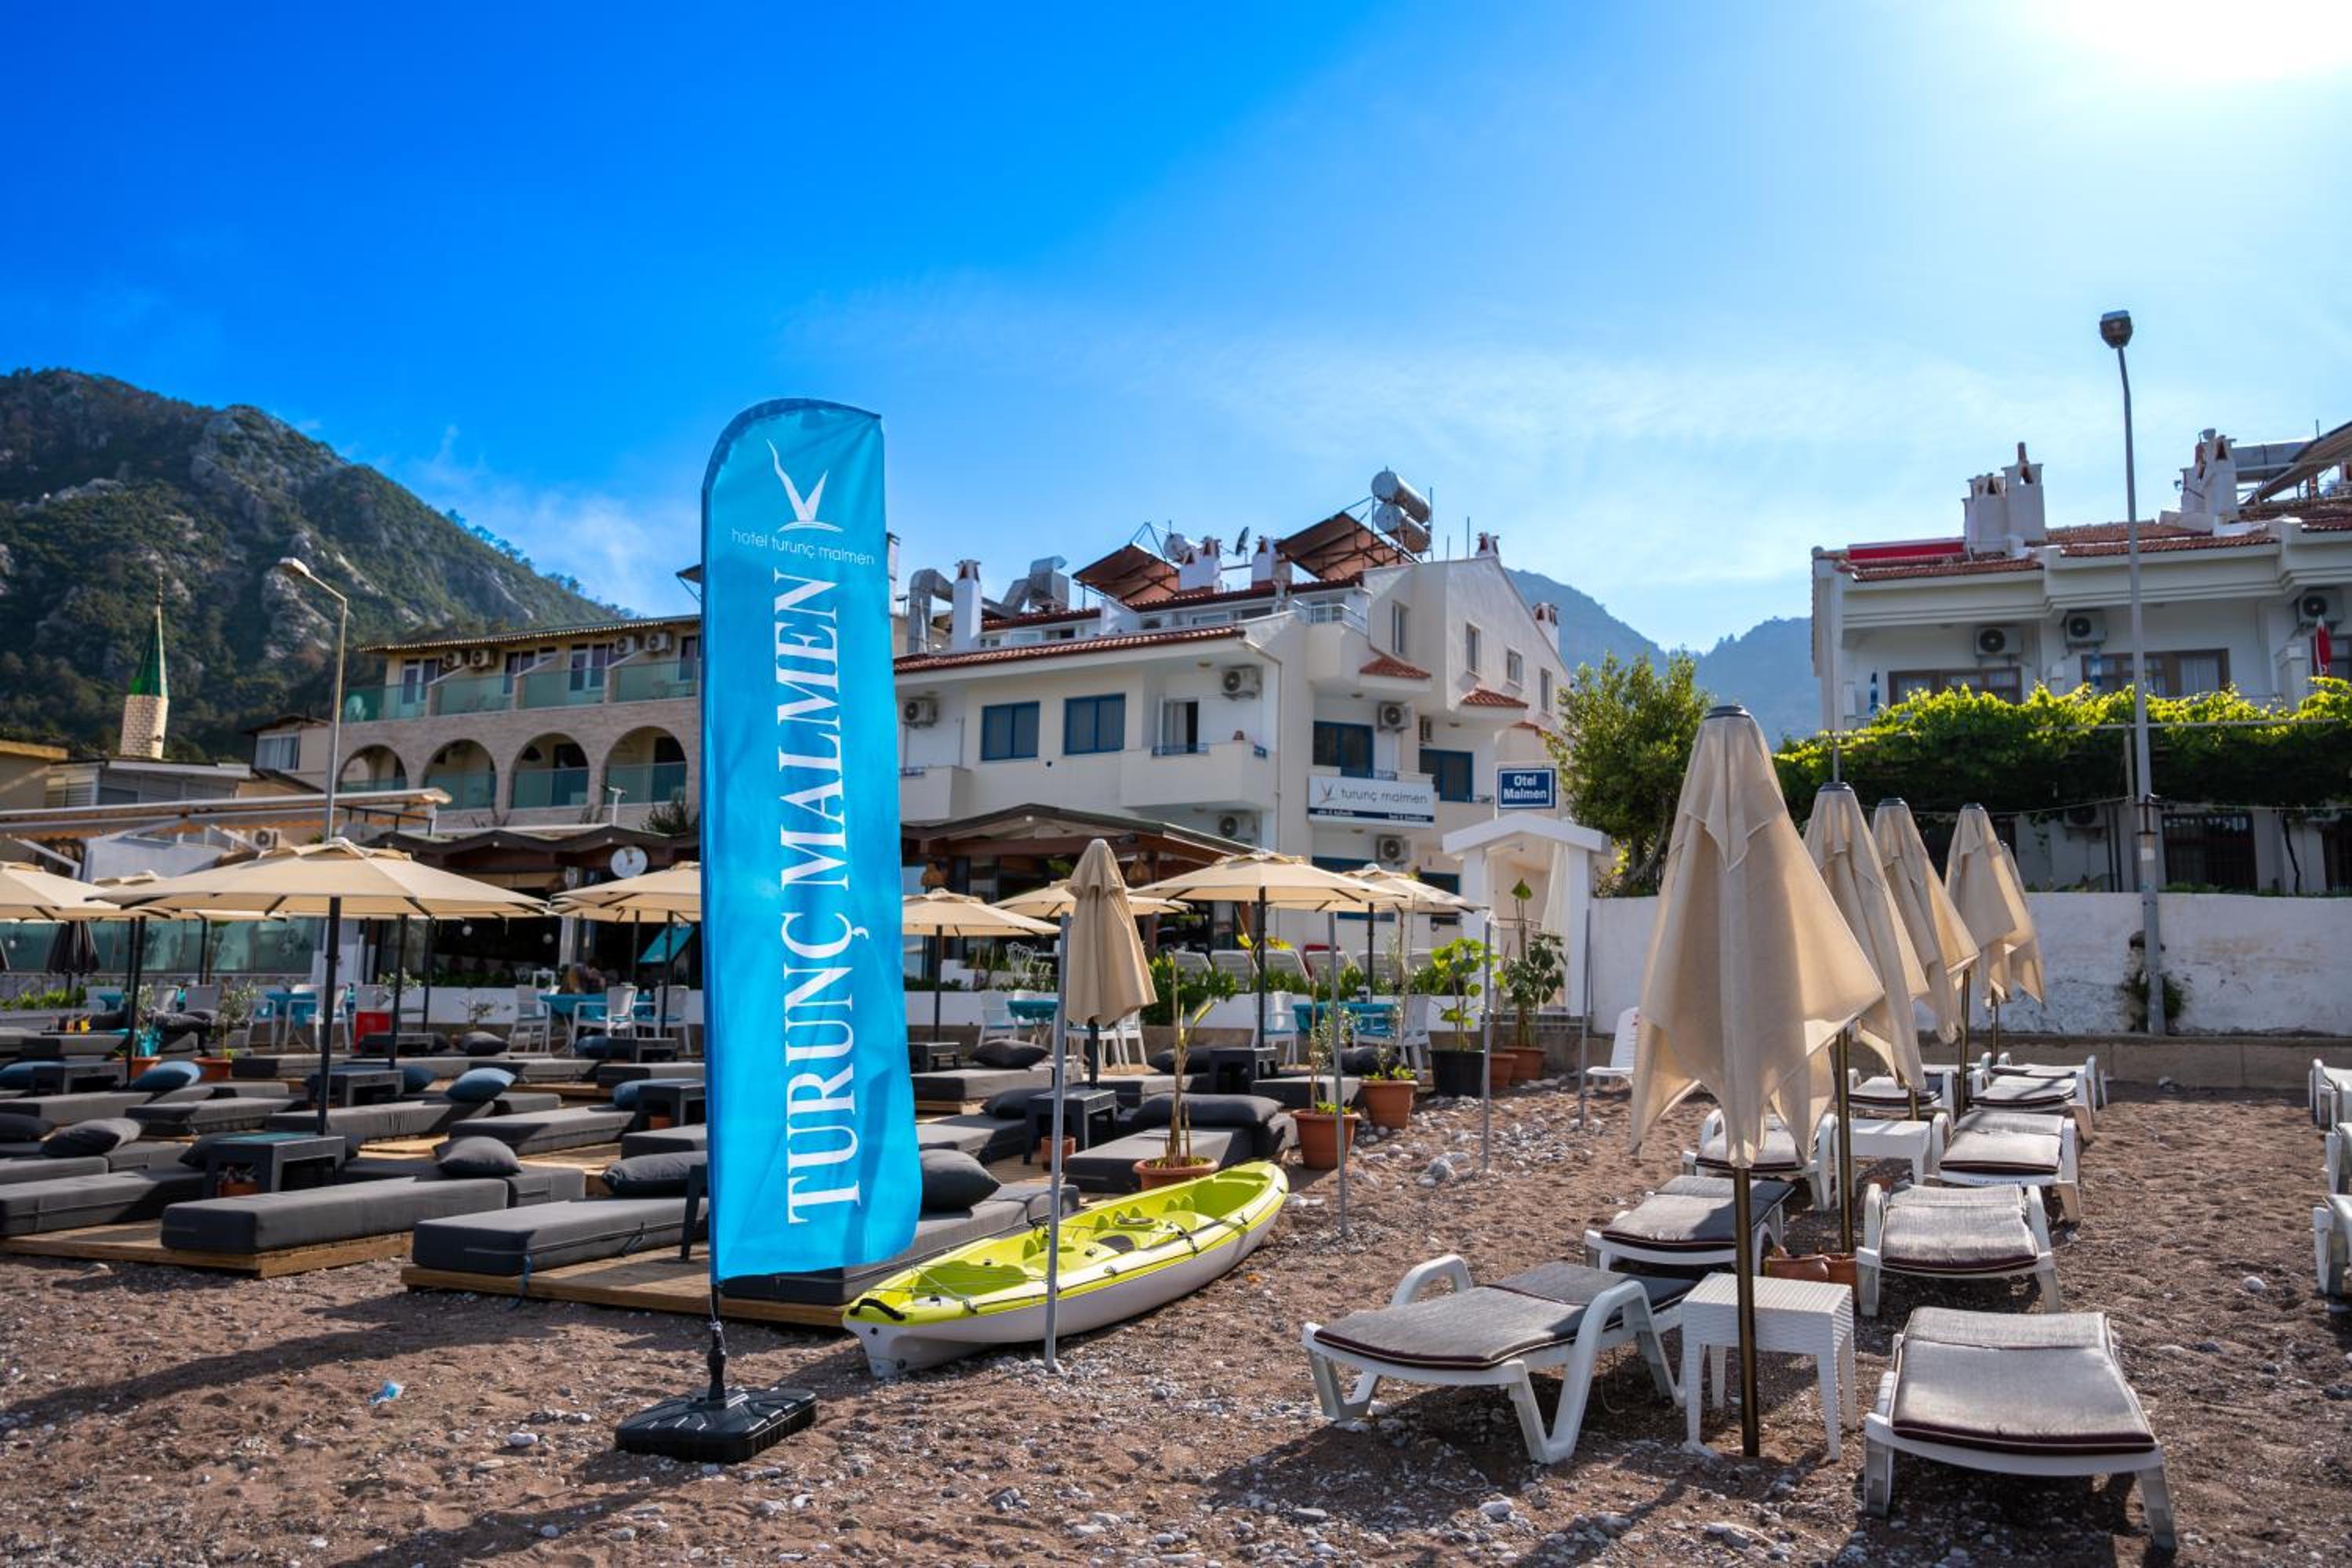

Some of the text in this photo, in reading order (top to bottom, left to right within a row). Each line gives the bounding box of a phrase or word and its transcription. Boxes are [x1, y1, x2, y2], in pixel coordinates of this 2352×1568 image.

[731, 528, 875, 565] hotel turunç malmen
[1514, 775, 1537, 786] Otel
[1341, 788, 1428, 804] turunç malmen
[1504, 788, 1547, 800] Malmen
[774, 568, 869, 1225] TURUNÇ MALMEN
